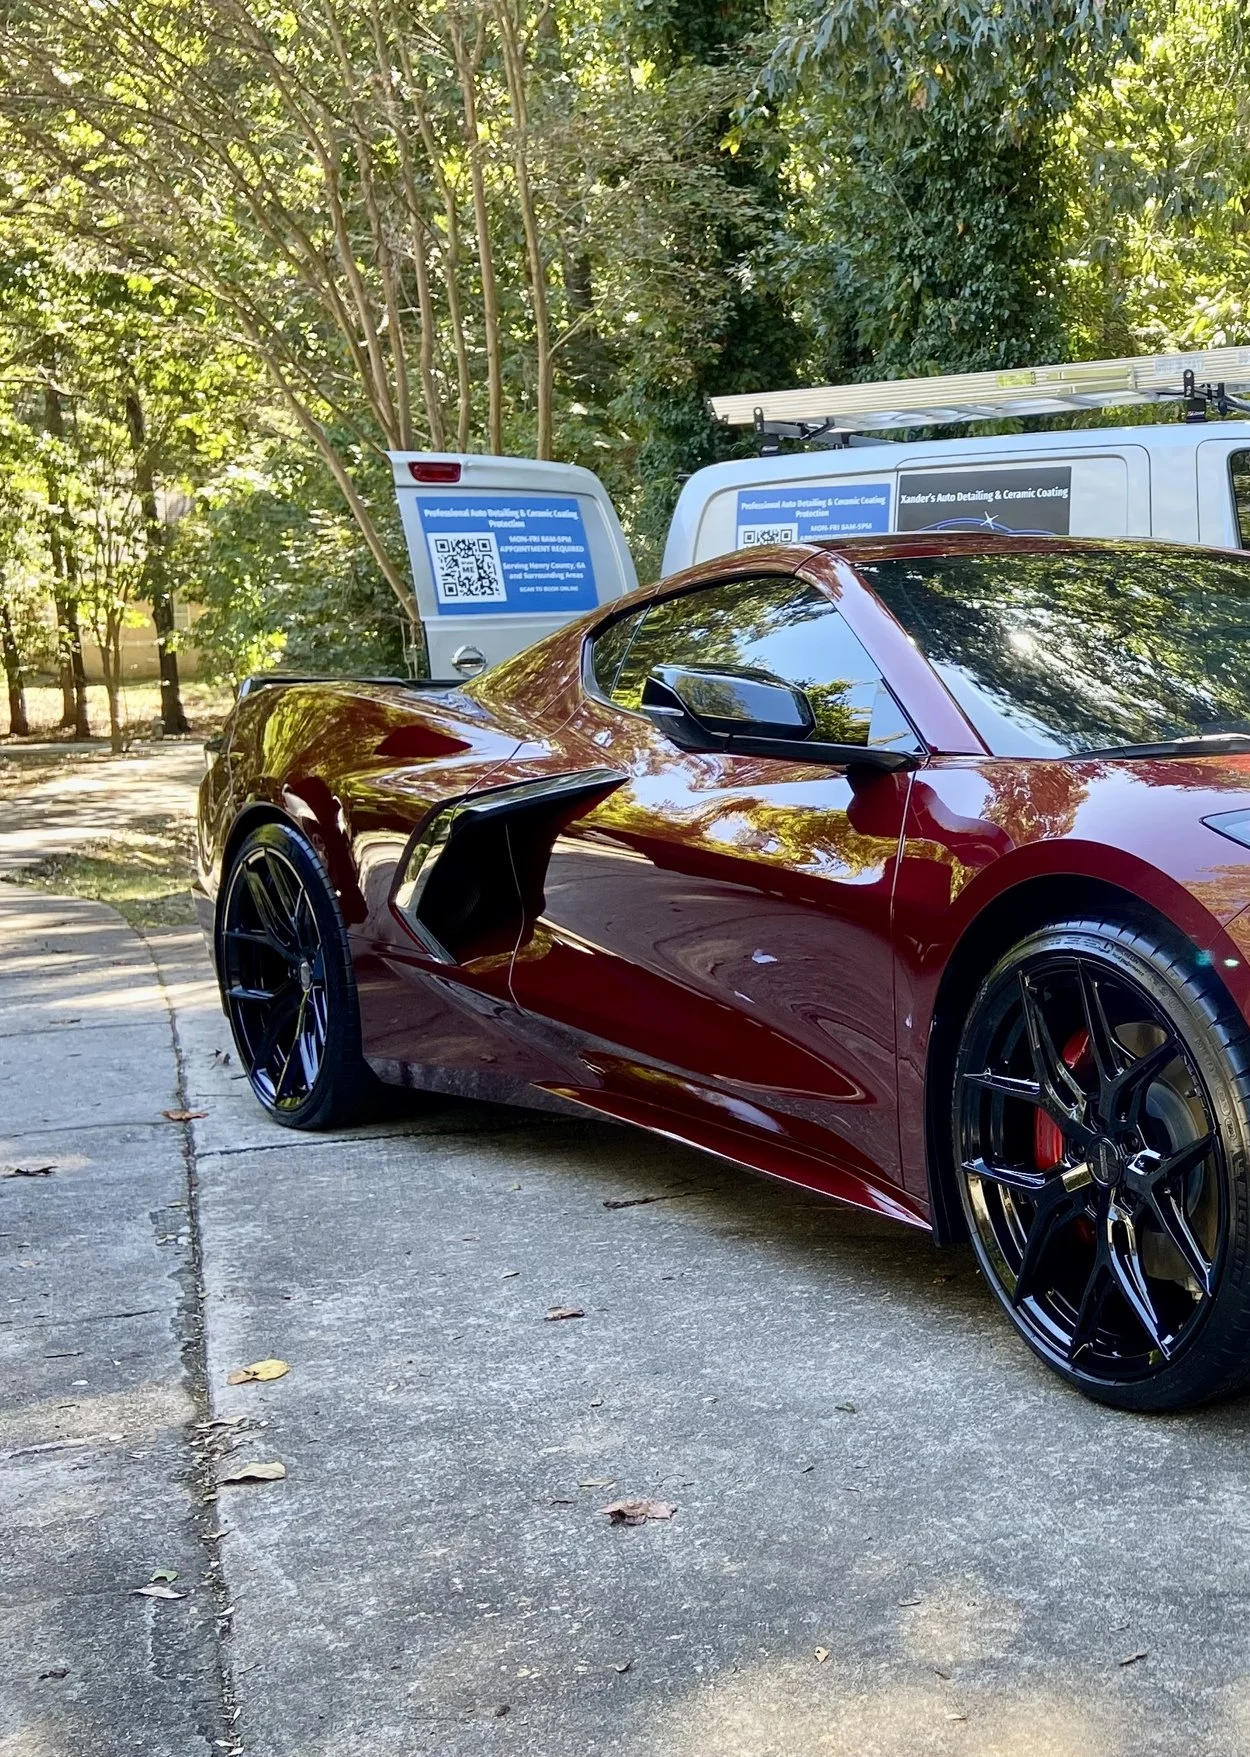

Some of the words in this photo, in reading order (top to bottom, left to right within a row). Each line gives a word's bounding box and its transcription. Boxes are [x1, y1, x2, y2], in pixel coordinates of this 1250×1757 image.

[900, 493, 936, 504] Xander's
[936, 493, 956, 502] Auto
[957, 490, 993, 502] Detailing
[994, 490, 1001, 500] &
[1003, 487, 1035, 500] Ceramic
[1036, 486, 1068, 499] Coating
[741, 501, 780, 510] Professional
[781, 500, 797, 508] Auto
[797, 498, 827, 508] Detailing
[827, 498, 833, 506] &
[834, 496, 860, 506] Ceramic
[860, 495, 886, 505] Coating
[424, 508, 469, 518] Professional
[470, 509, 487, 517] Auto
[487, 508, 520, 519] Detailing
[520, 509, 526, 517] &
[527, 509, 553, 518] Ceramic
[553, 509, 579, 520] Coating
[795, 508, 829, 518] Protection
[488, 519, 525, 528] Protection
[811, 524, 840, 532] MON-FRI
[841, 523, 873, 531] 8AM-5PM
[500, 545, 550, 553] APPOINTMENT
[503, 562, 529, 571] Serving
[529, 562, 550, 570] Henry
[551, 562, 576, 570] County,
[523, 572, 565, 580] Surrounding
